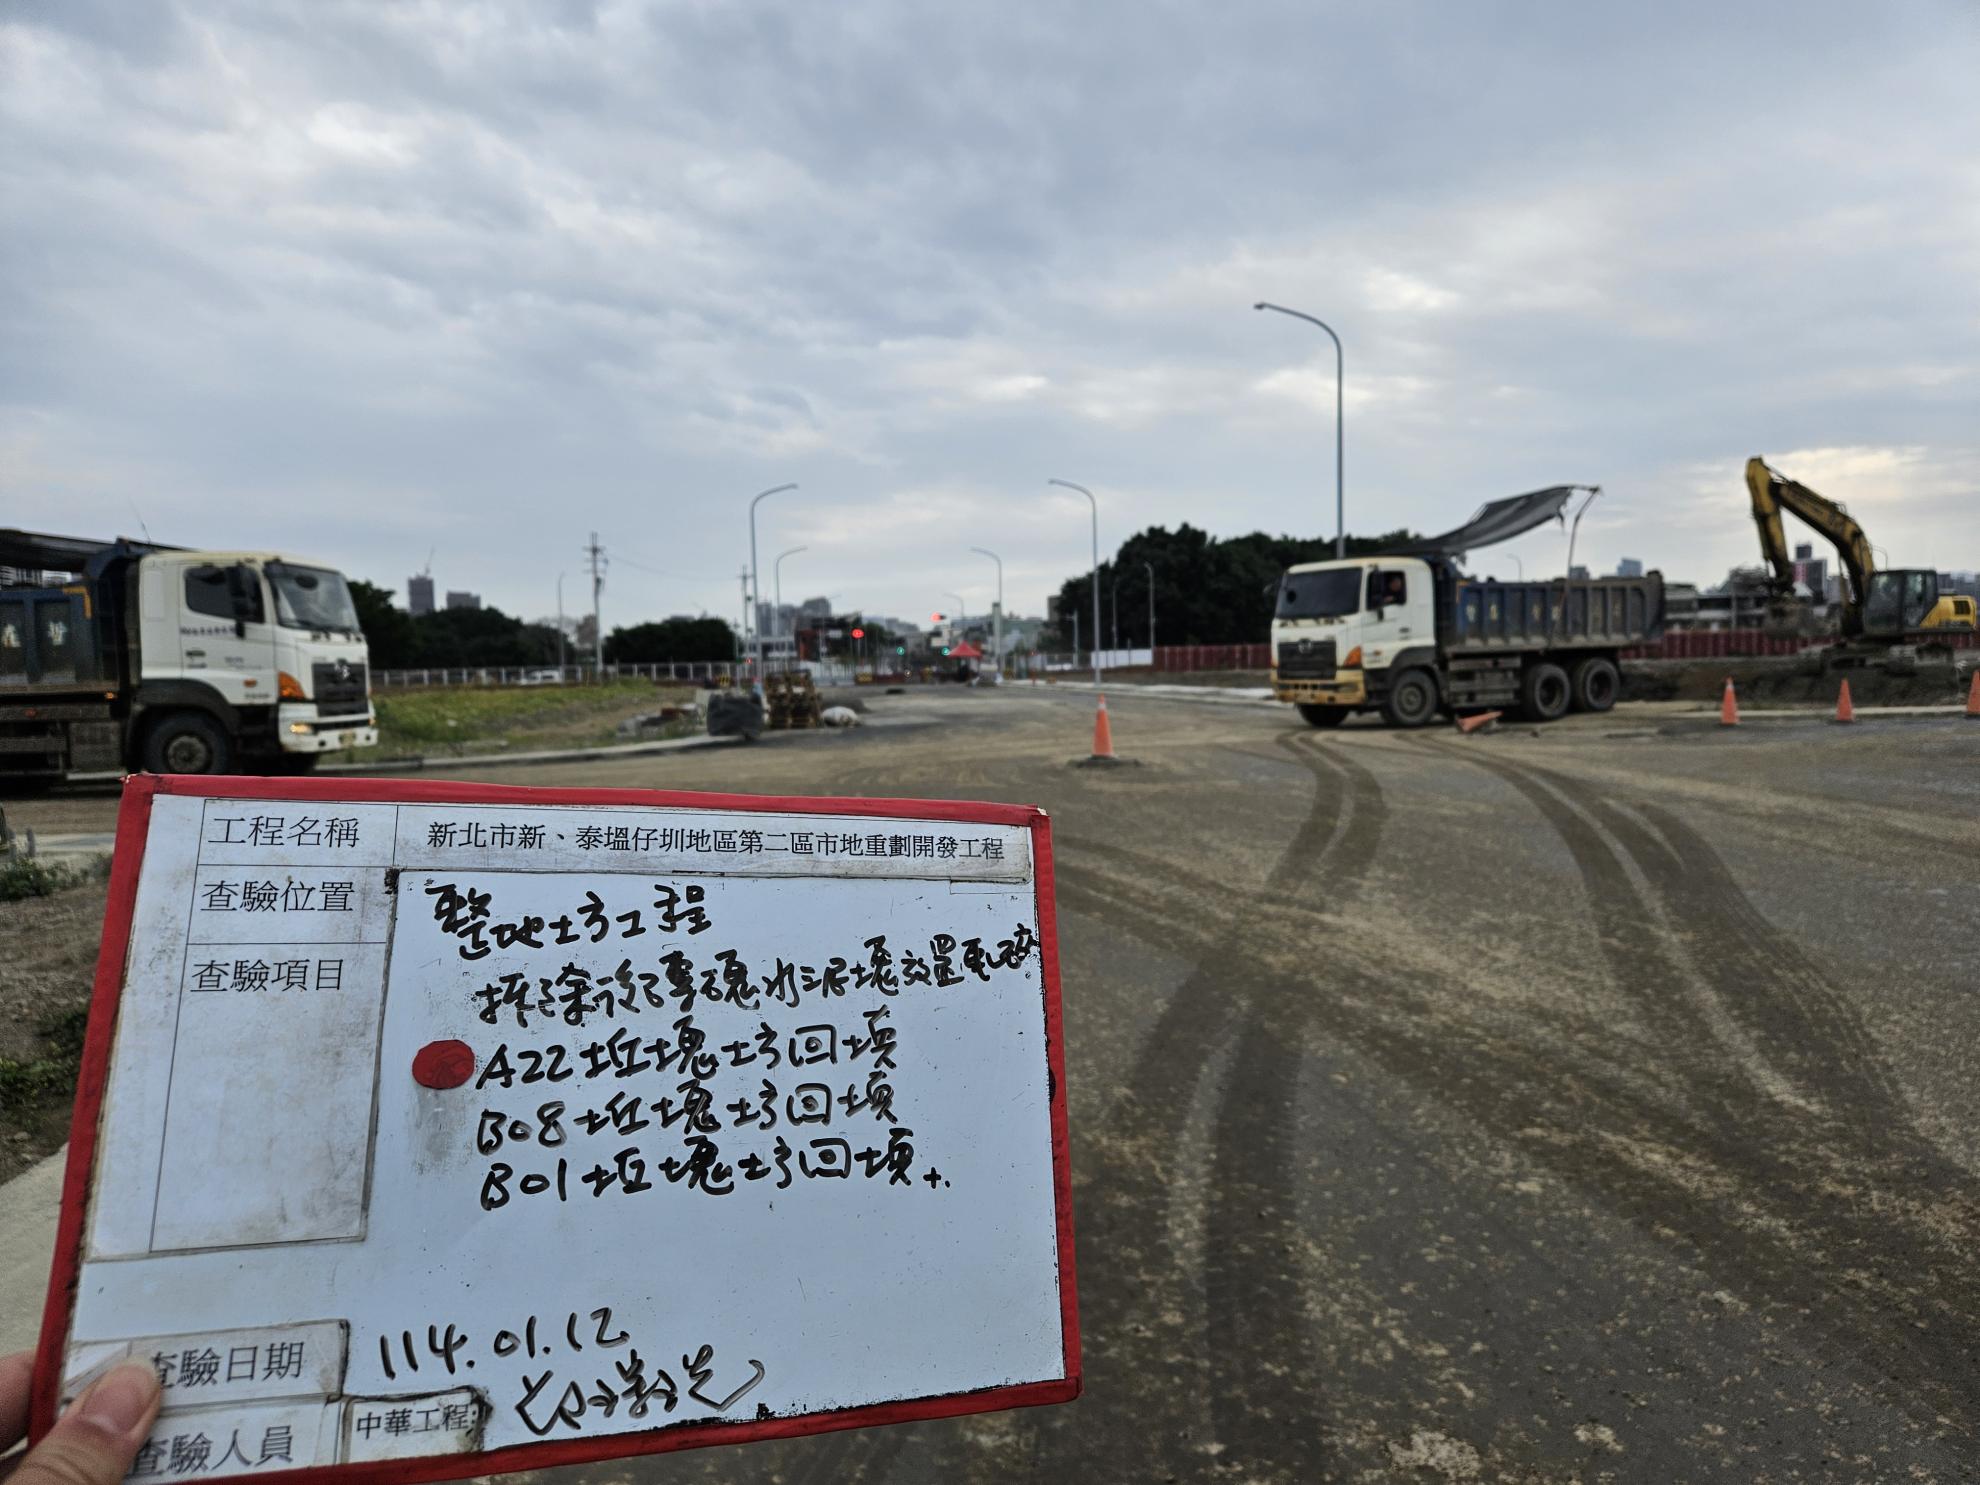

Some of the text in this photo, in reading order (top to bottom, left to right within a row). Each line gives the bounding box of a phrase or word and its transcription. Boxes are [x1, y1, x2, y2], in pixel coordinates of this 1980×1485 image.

[207, 815, 361, 850] 工程名稱
[200, 879, 355, 914] 查驗位置
[424, 883, 712, 961] 整地土方工程
[190, 957, 345, 994] 查驗項目
